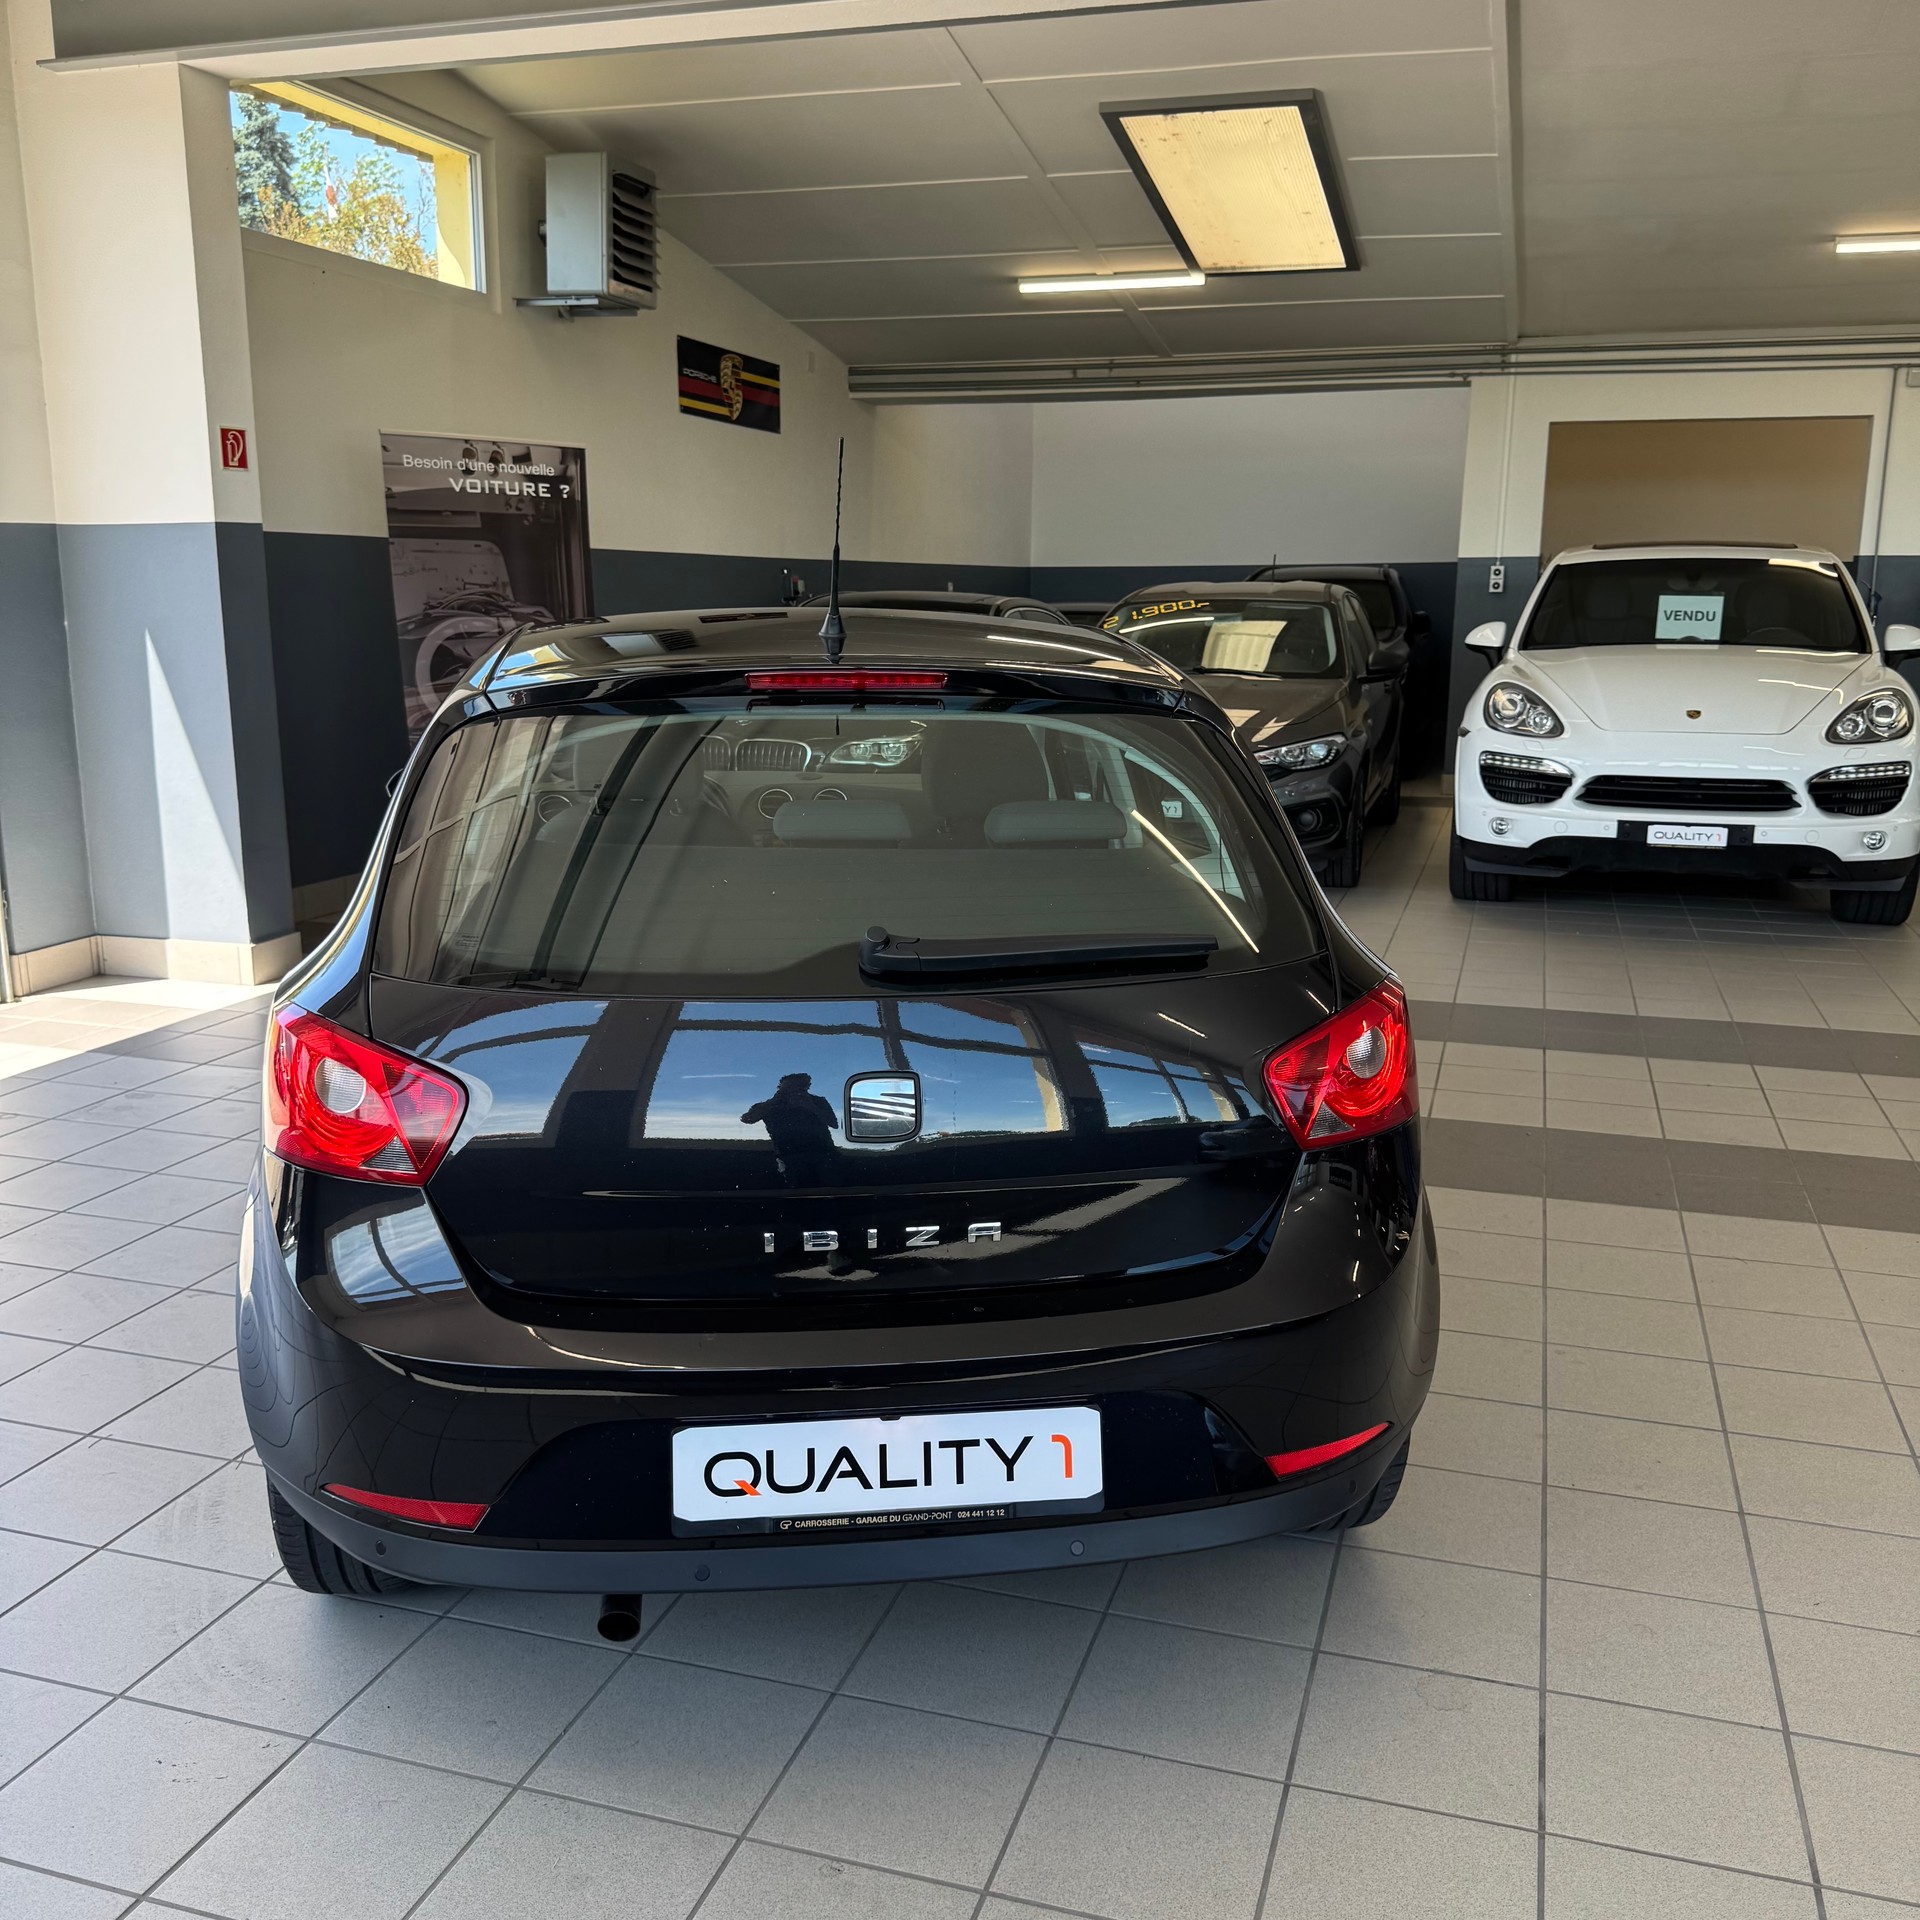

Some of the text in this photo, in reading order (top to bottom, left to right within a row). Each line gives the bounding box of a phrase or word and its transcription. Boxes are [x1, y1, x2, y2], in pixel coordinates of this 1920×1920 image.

[402, 454, 555, 476] Besoin d'une nouvelle
[449, 477, 570, 498] VOITURE ?
[1663, 610, 1716, 621] VENDU
[1653, 831, 1721, 842] QUALITY 1
[763, 1221, 1002, 1253] IBIZA
[703, 1434, 1073, 1498] QUALITY 1
[794, 1517, 850, 1529] CARROSSERIE
[855, 1514, 888, 1525] GARAGE
[889, 1514, 901, 1523] DU
[902, 1511, 952, 1522] GRAND-PONT
[957, 1511, 970, 1519] 024
[971, 1510, 984, 1518] 441
[987, 1509, 995, 1517] 12
[997, 1508, 1005, 1516] 12
